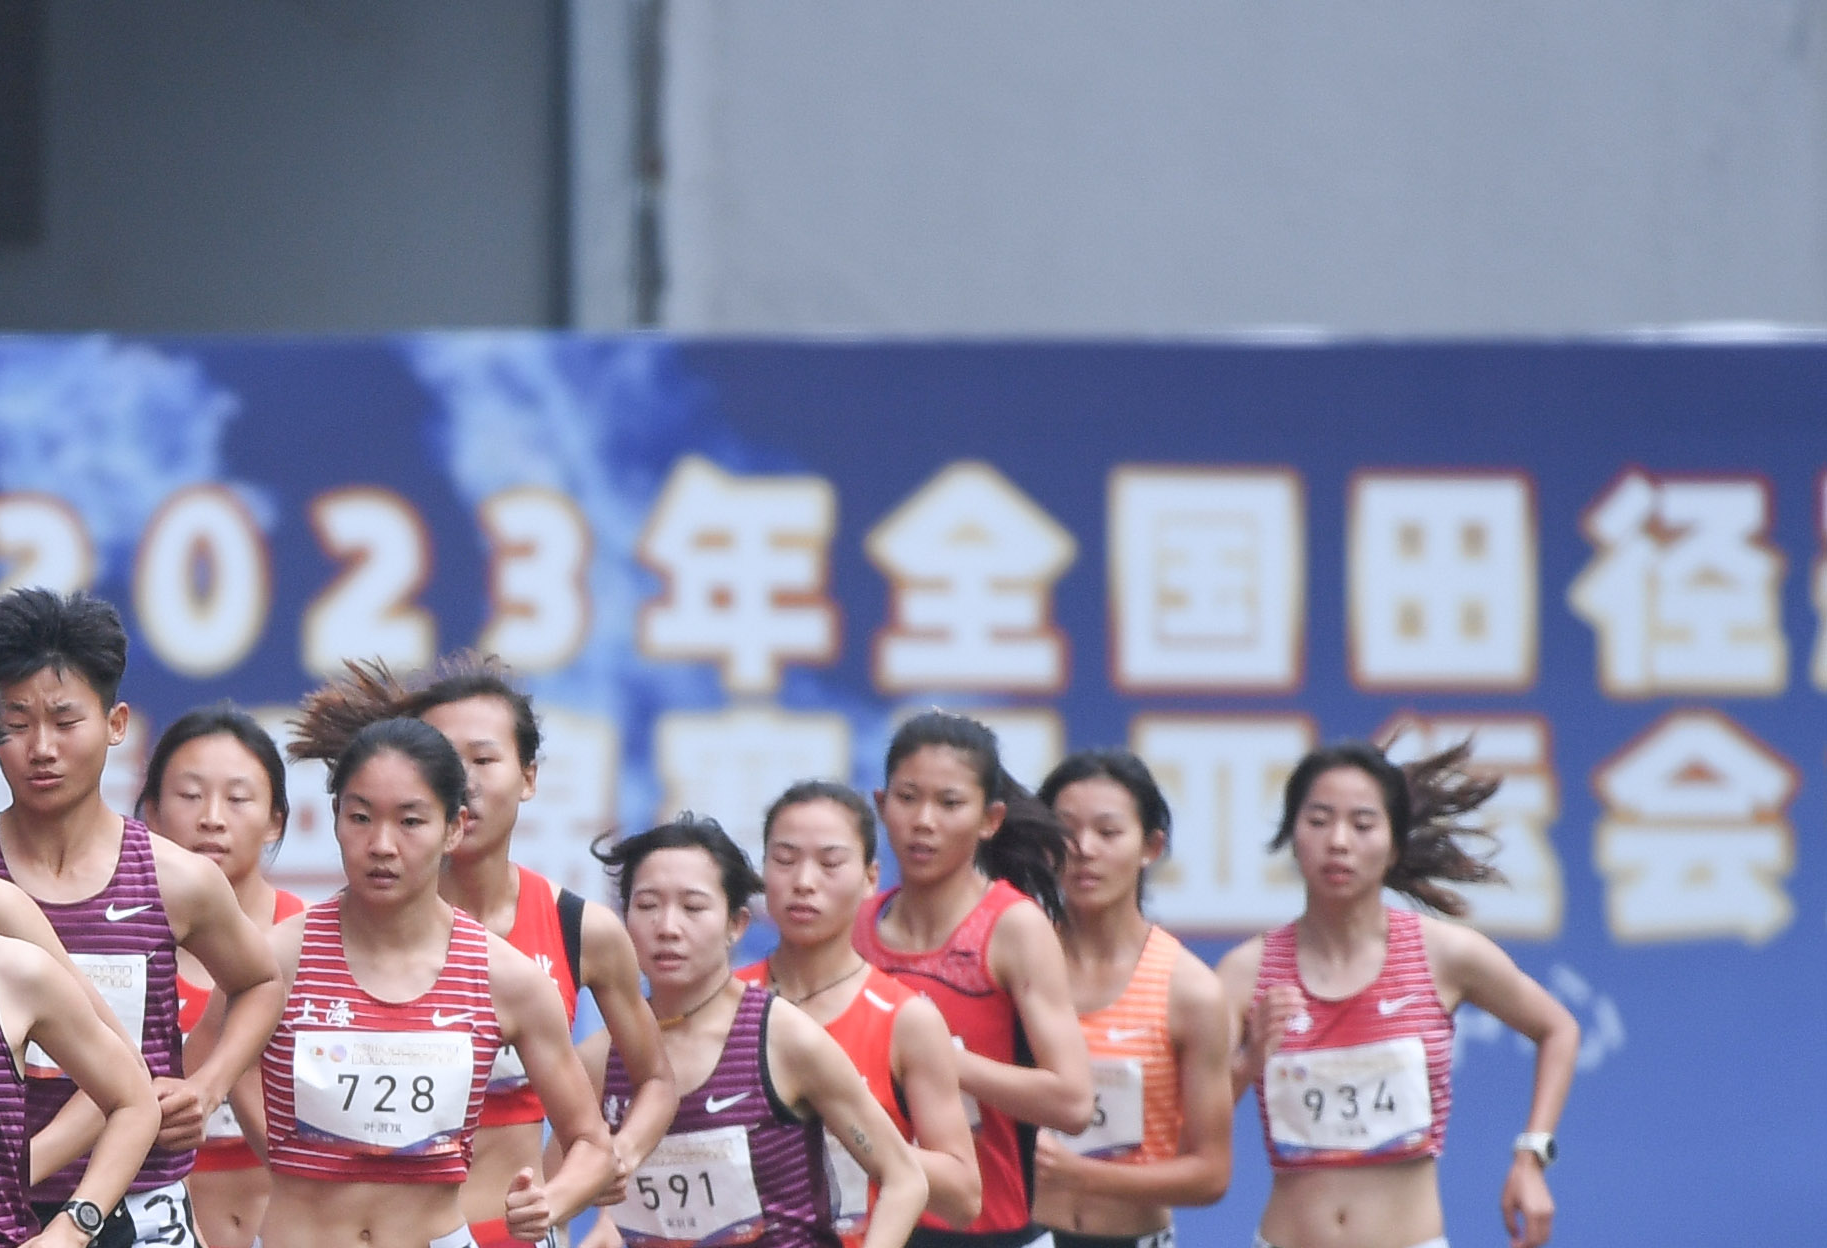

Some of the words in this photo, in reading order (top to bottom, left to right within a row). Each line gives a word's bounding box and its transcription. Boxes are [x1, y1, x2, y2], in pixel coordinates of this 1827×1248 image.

[293, 999, 355, 1028] 上海
[337, 1074, 435, 1113] 728
[1304, 1080, 1396, 1121] 934
[636, 1171, 715, 1210] 591
[143, 1193, 187, 1246] 3
